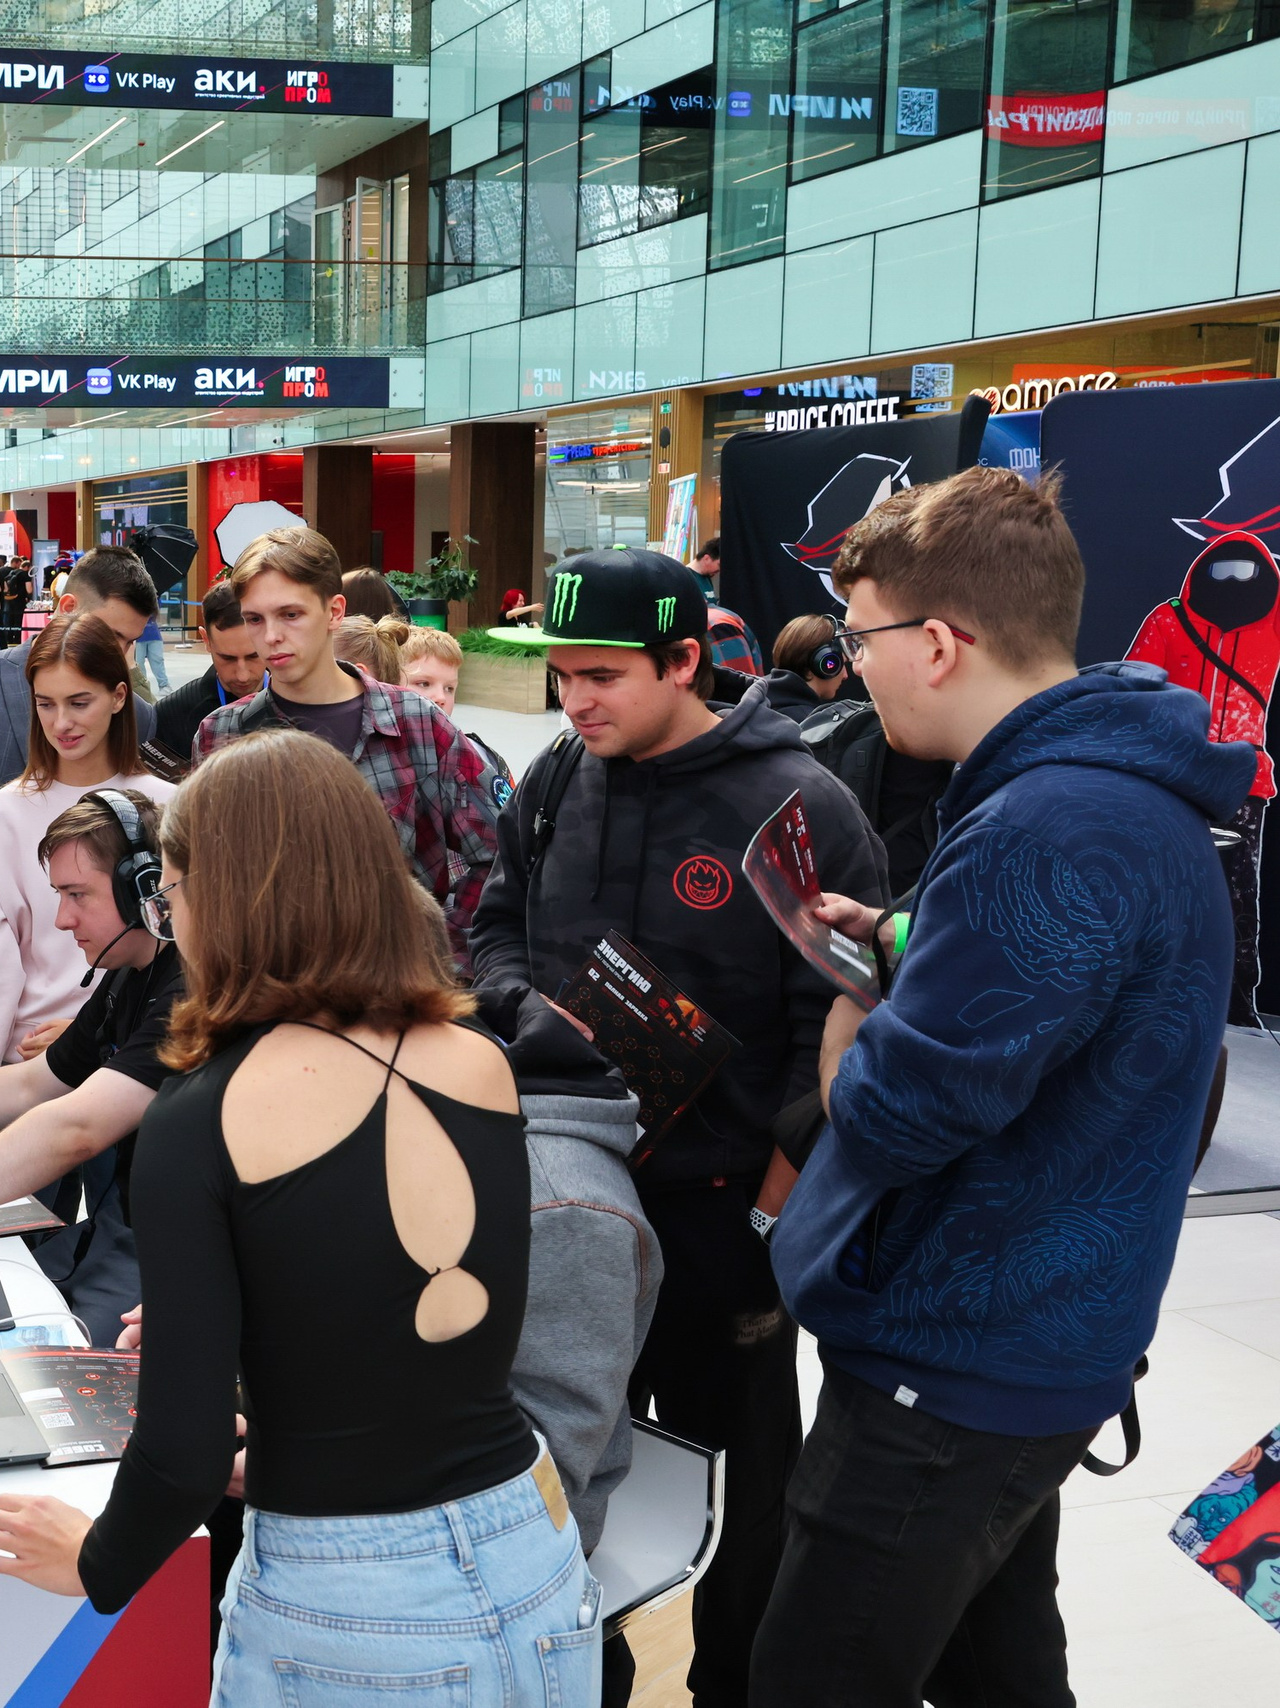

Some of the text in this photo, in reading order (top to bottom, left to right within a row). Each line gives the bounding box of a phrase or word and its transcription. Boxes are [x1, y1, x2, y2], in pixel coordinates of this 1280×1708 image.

[116, 72, 176, 93] VK Play
[287, 70, 328, 86] ИГРО
[284, 87, 332, 103] ПРОМ
[285, 366, 326, 382] ИГРО
[117, 374, 176, 392] VK Play
[282, 382, 329, 397] ПРОМ
[596, 938, 652, 994] ЭНЕРГИЮ
